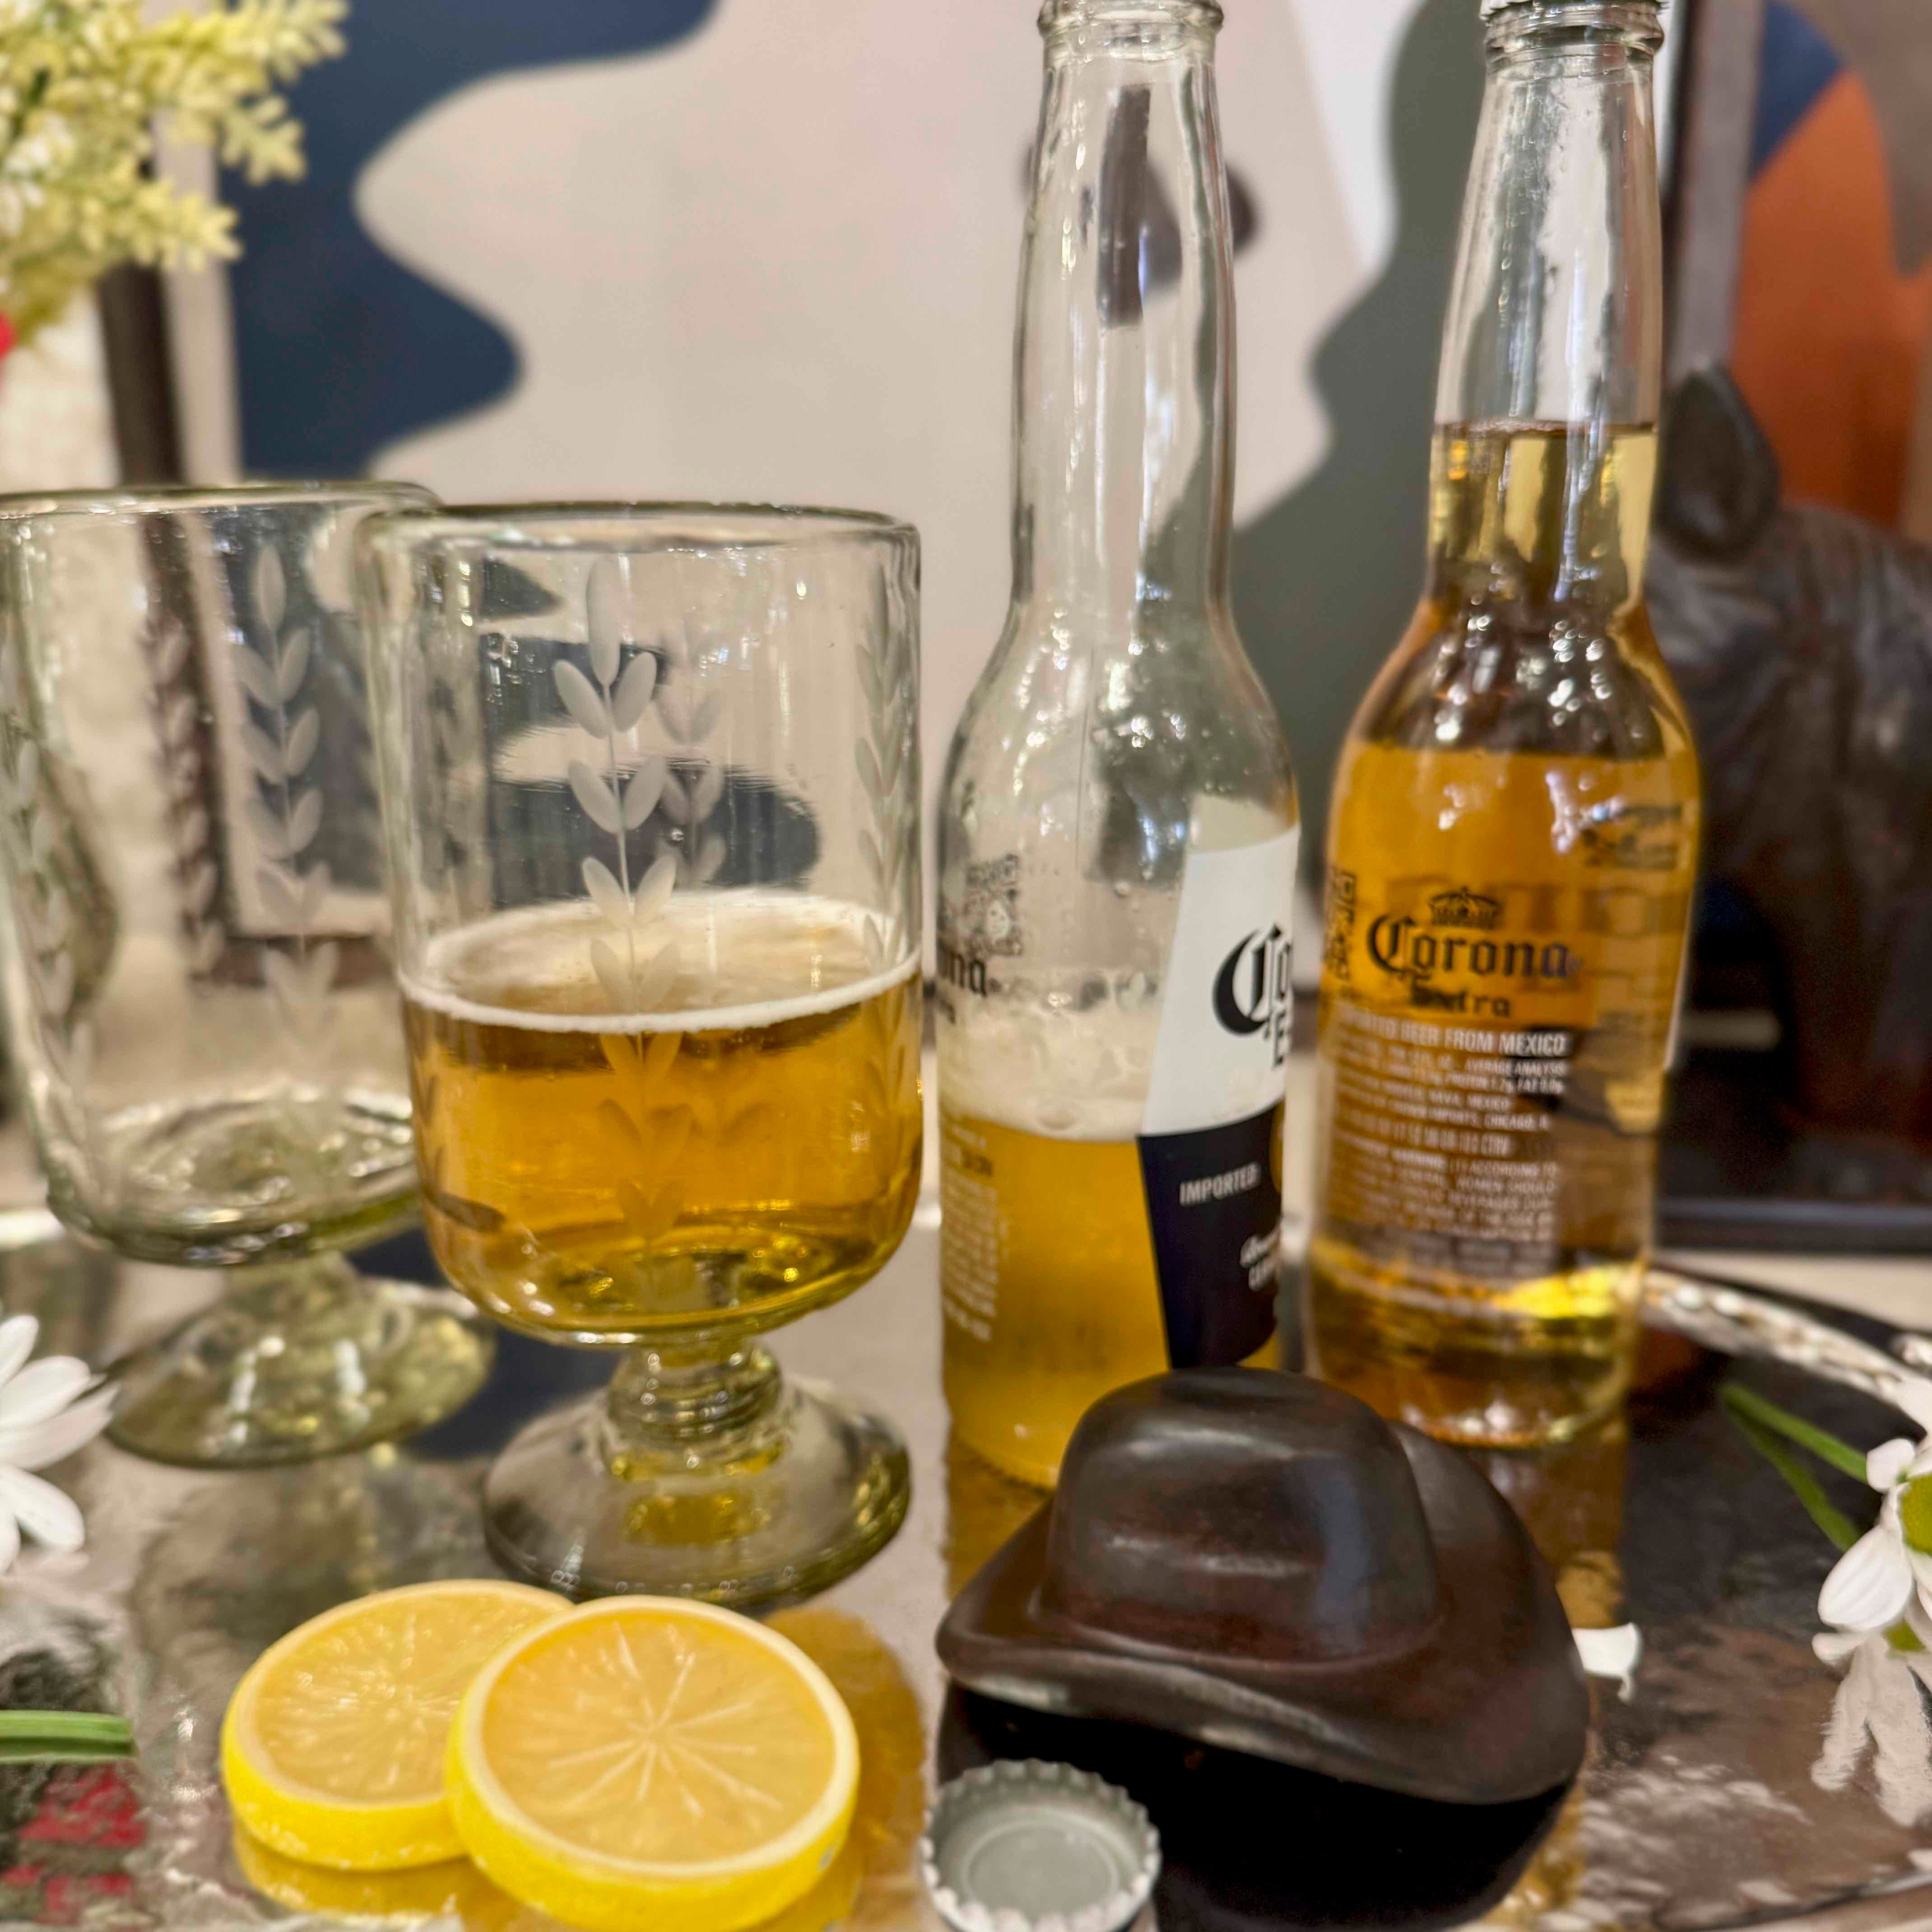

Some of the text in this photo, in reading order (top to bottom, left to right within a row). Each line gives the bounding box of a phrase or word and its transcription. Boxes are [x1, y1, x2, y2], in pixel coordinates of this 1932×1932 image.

[1367, 915, 1568, 980] Corona
[1444, 1026, 1495, 1054] FROM
[1498, 1031, 1568, 1057] MEXICO
[1513, 1059, 1570, 1077] ANALYSIS
[1179, 1161, 1263, 1206] IMPORTED
